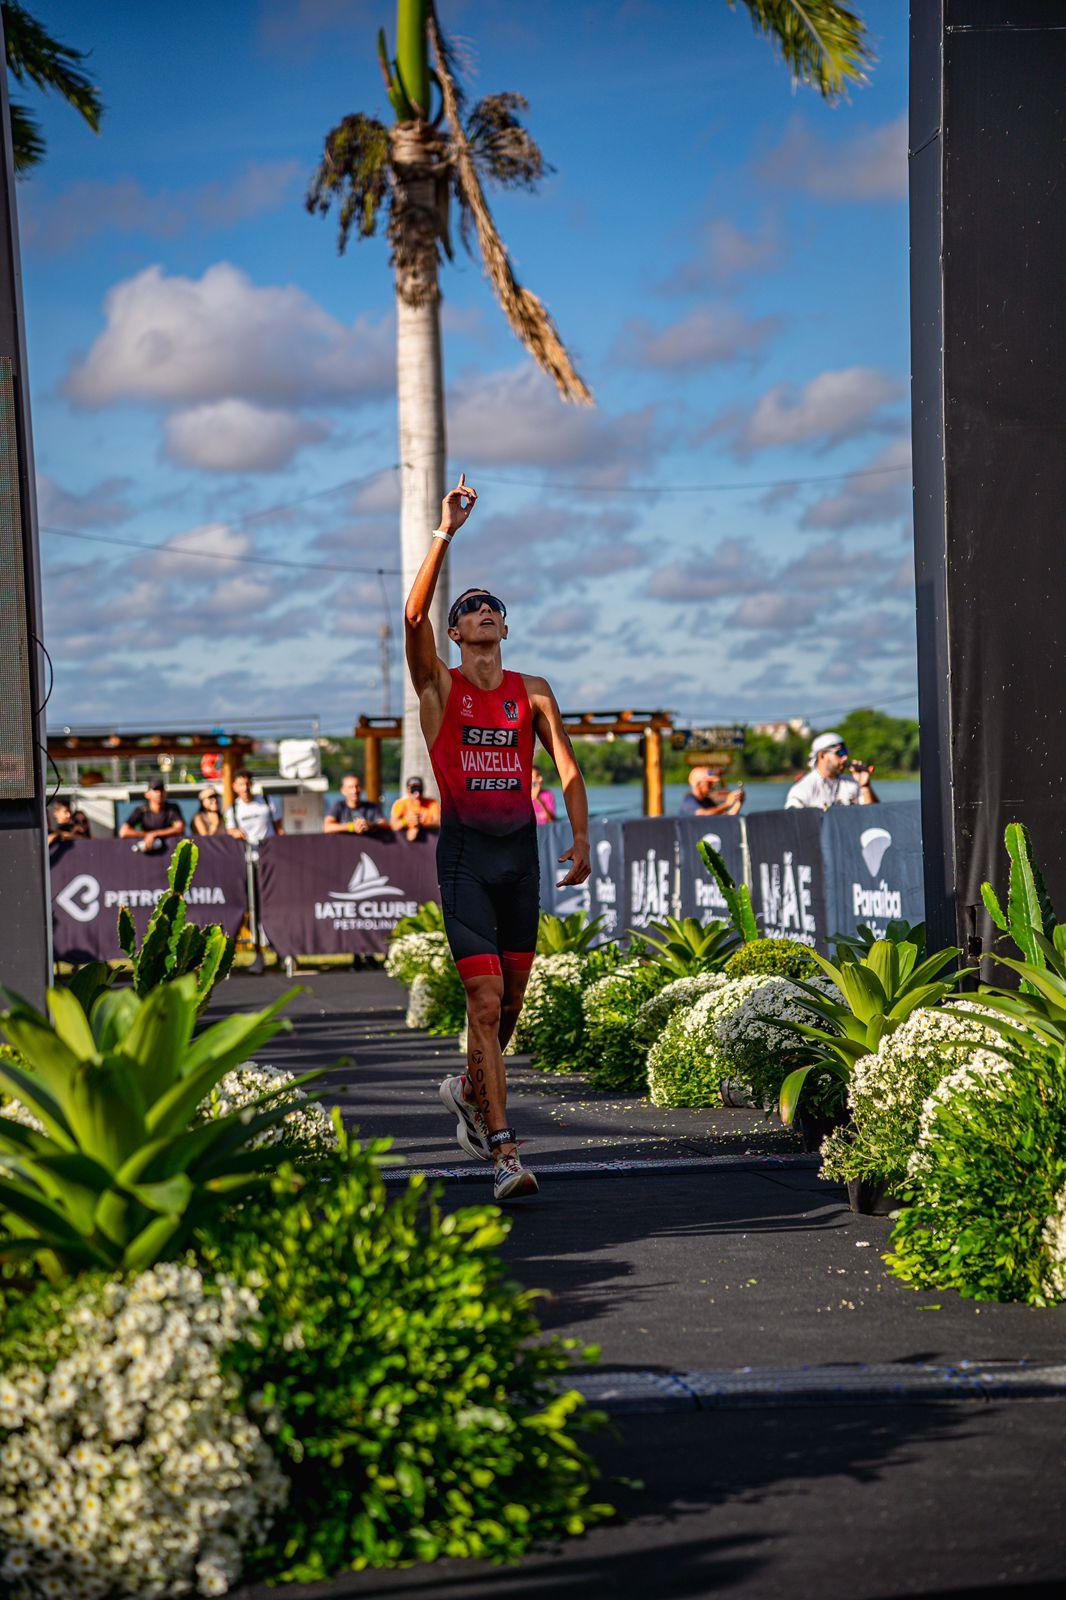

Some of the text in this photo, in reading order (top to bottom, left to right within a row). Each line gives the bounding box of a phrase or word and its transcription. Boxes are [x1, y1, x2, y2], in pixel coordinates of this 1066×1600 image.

[467, 728, 513, 746] SESI
[460, 750, 523, 772] VANZELLA
[470, 778, 518, 790] FIESP
[104, 886, 226, 908] PETROAHIA
[852, 879, 902, 919] Paraíba
[315, 902, 357, 920] IATE
